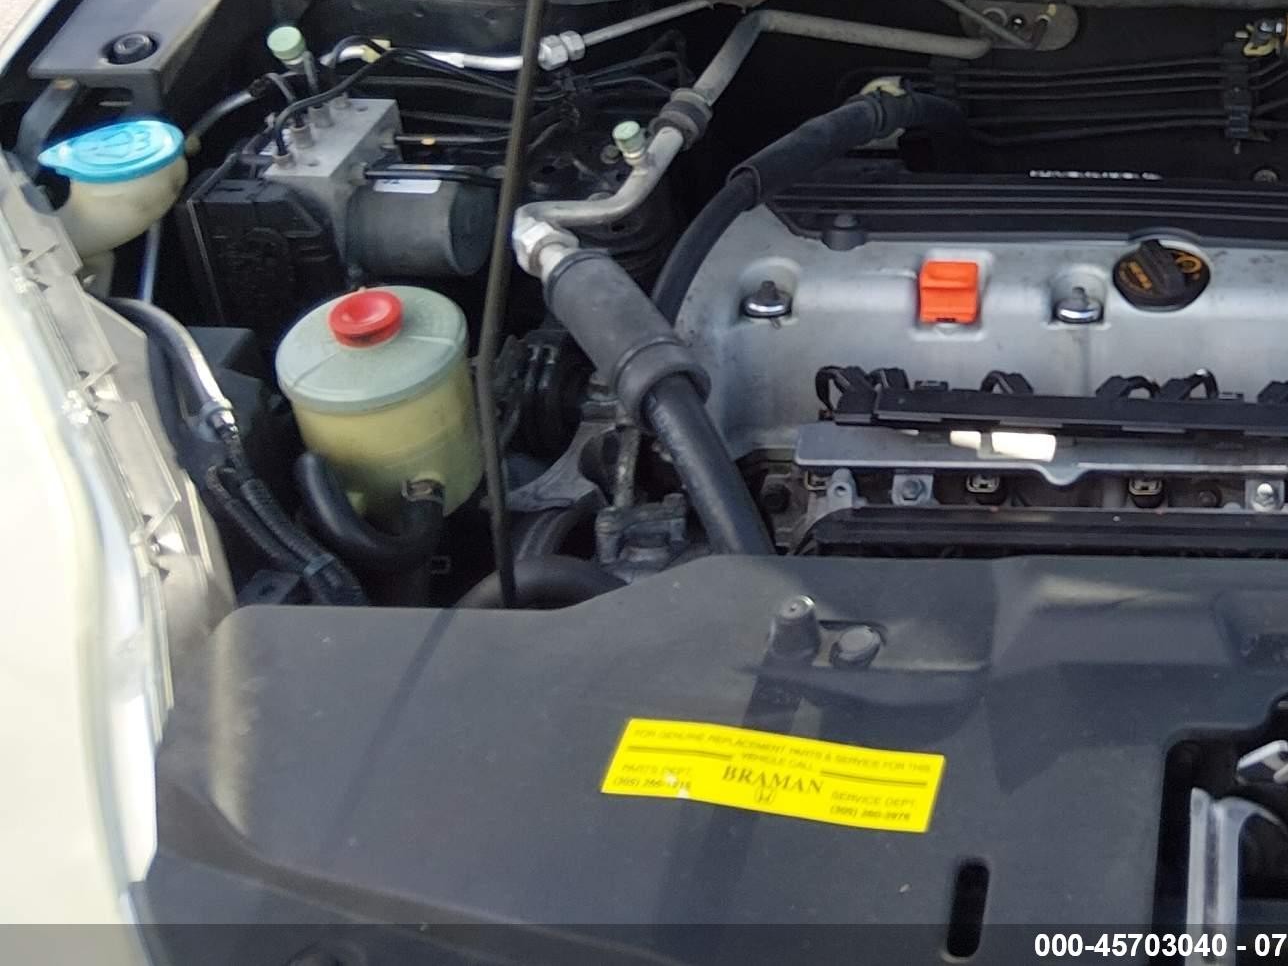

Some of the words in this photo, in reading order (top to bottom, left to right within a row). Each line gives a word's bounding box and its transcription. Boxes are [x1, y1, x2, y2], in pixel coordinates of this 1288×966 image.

[634, 729, 656, 739] FOR
[658, 730, 704, 741] GENUINE
[707, 734, 785, 754] REPLACEMENT
[789, 746, 822, 761] PARTS
[834, 754, 880, 769] SERVICE
[883, 760, 905, 771] FOR
[621, 763, 658, 774] PARTS
[741, 752, 787, 766] VEHICLE
[788, 758, 814, 771] CALL
[721, 764, 825, 794] BRAMAN
[831, 790, 880, 805] SERVICE
